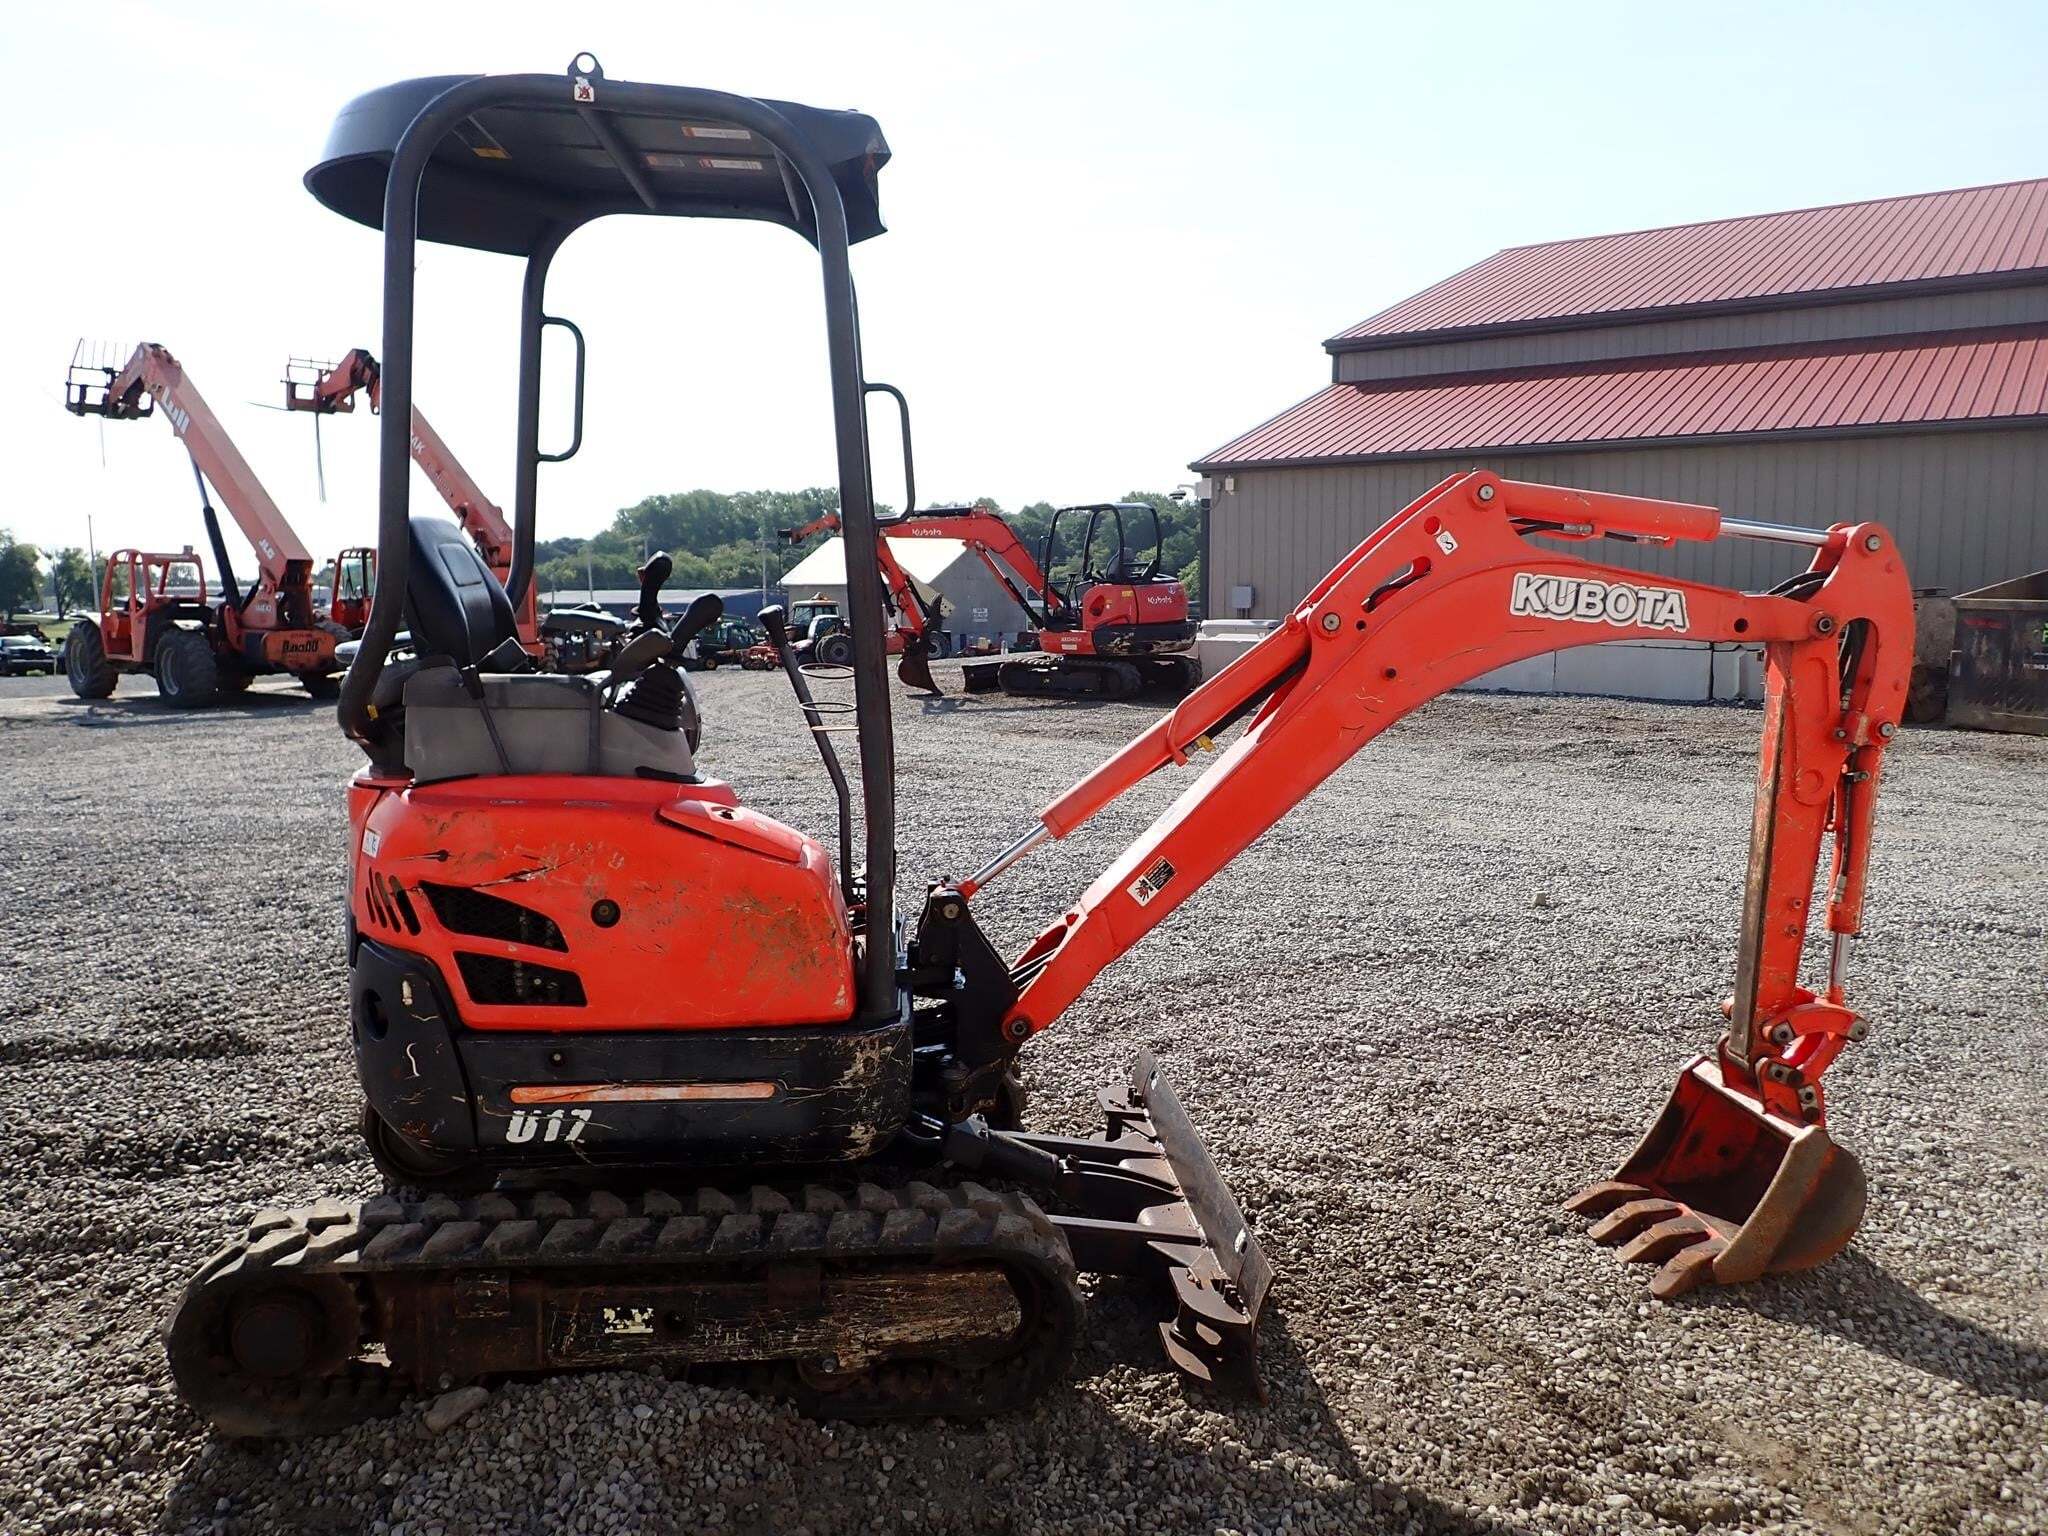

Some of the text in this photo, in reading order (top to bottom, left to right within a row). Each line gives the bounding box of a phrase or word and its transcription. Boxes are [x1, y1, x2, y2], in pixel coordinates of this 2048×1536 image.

[911, 528, 943, 537] Kubota
[258, 539, 276, 560] JLG
[1511, 573, 1690, 631] KUBOTA
[506, 1109, 593, 1143] U17
